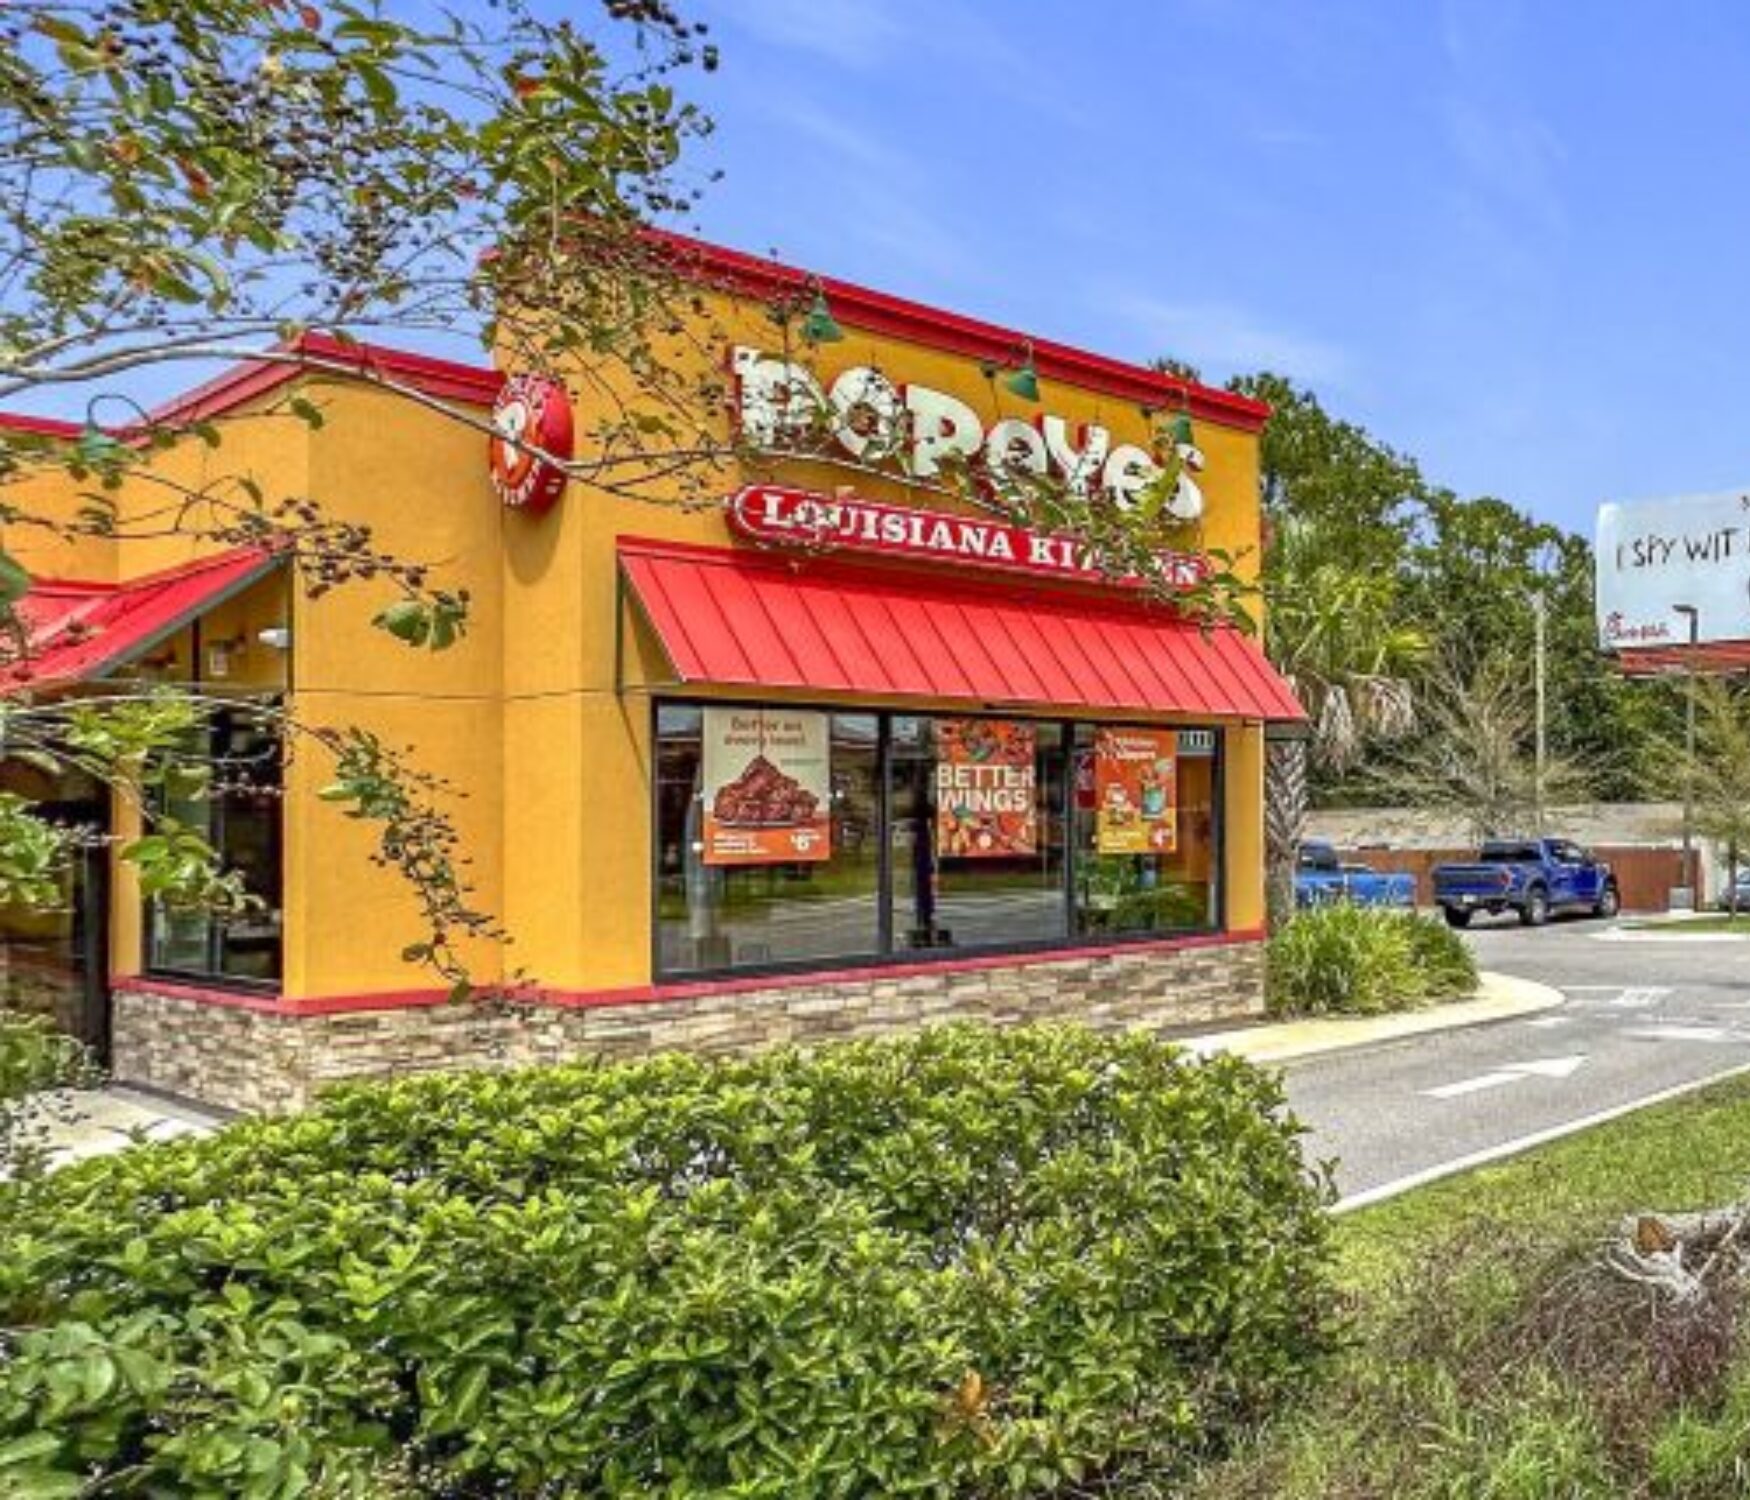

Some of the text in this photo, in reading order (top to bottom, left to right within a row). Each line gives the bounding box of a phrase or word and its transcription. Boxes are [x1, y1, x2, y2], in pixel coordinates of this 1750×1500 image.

[1616, 545, 1623, 571] I
[1632, 533, 1677, 567] SPY
[1683, 527, 1740, 562] WIT
[937, 763, 1037, 788] BETTER
[937, 788, 1028, 813] WINGS
